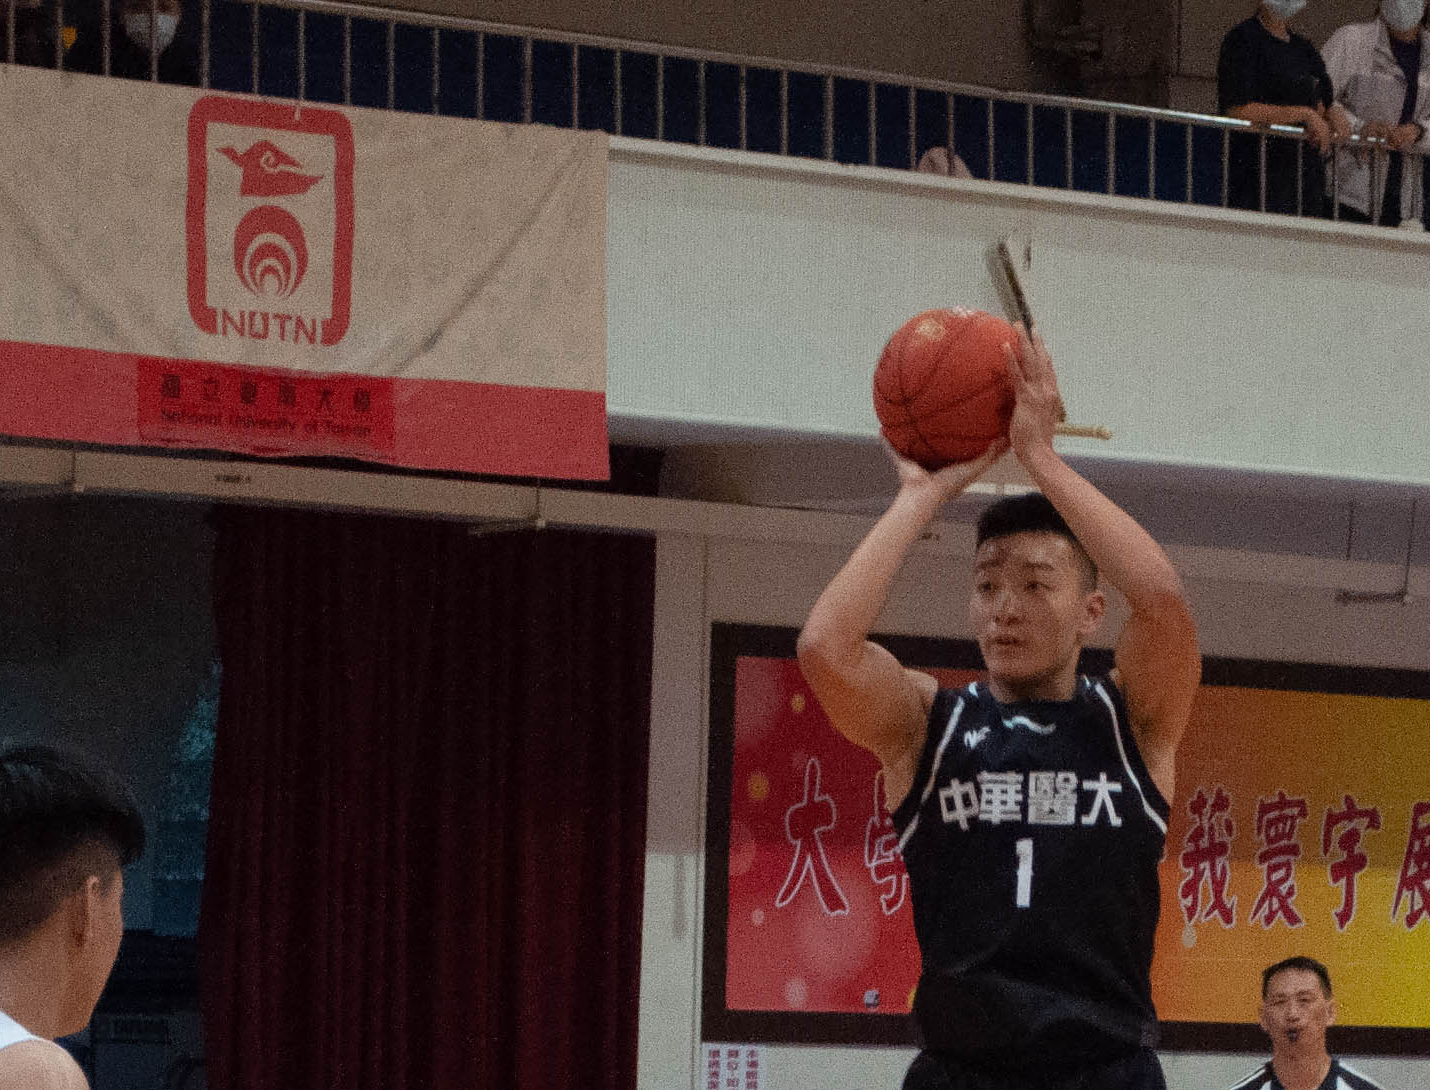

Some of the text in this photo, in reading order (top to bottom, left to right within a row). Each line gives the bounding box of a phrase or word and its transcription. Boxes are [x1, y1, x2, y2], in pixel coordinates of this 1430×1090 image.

[221, 308, 318, 346] NUTN
[937, 769, 1125, 831] 中華醫大
[1014, 836, 1035, 909] 1
